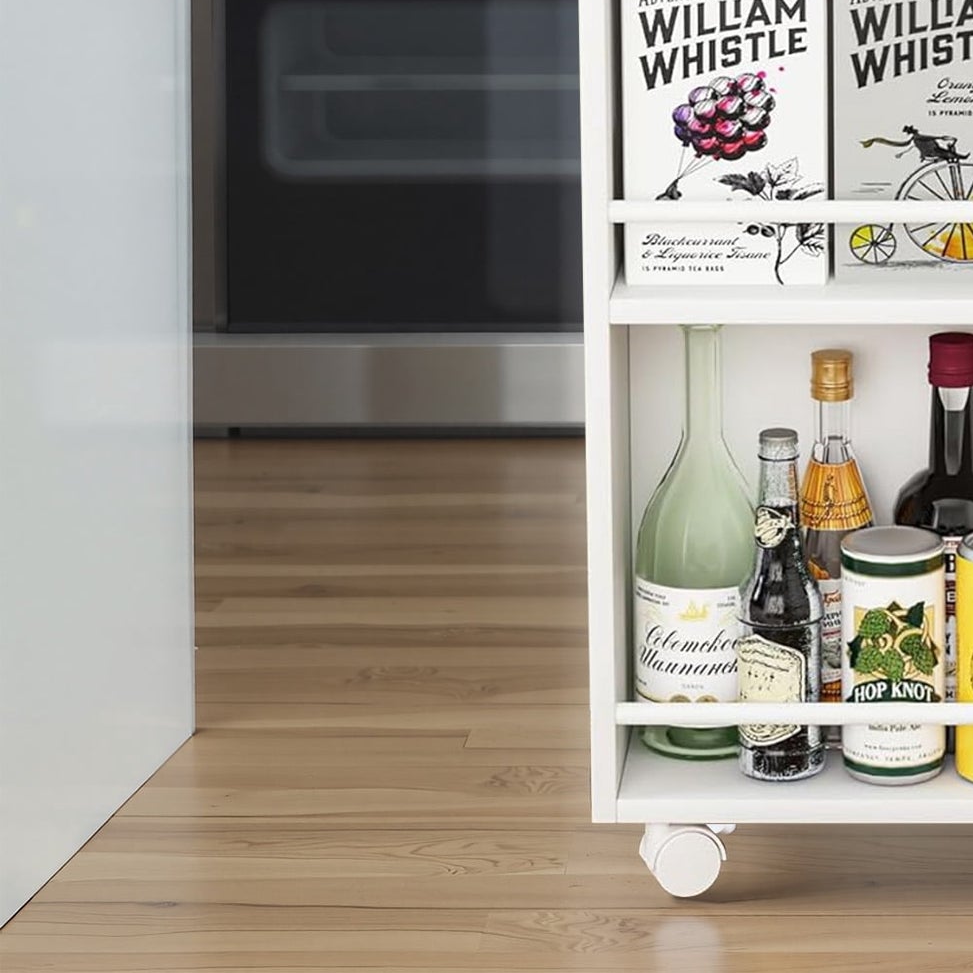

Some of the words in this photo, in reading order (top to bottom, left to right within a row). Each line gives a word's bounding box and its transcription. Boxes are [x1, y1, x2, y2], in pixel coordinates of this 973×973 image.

[638, 27, 808, 90] WHISTLE
[641, 233, 740, 247] Blackcurrant
[641, 248, 651, 259] &
[654, 246, 724, 263] Liquorice
[726, 246, 771, 259] Tisane
[854, 681, 888, 702] HOP
[891, 681, 934, 702] KNOT
